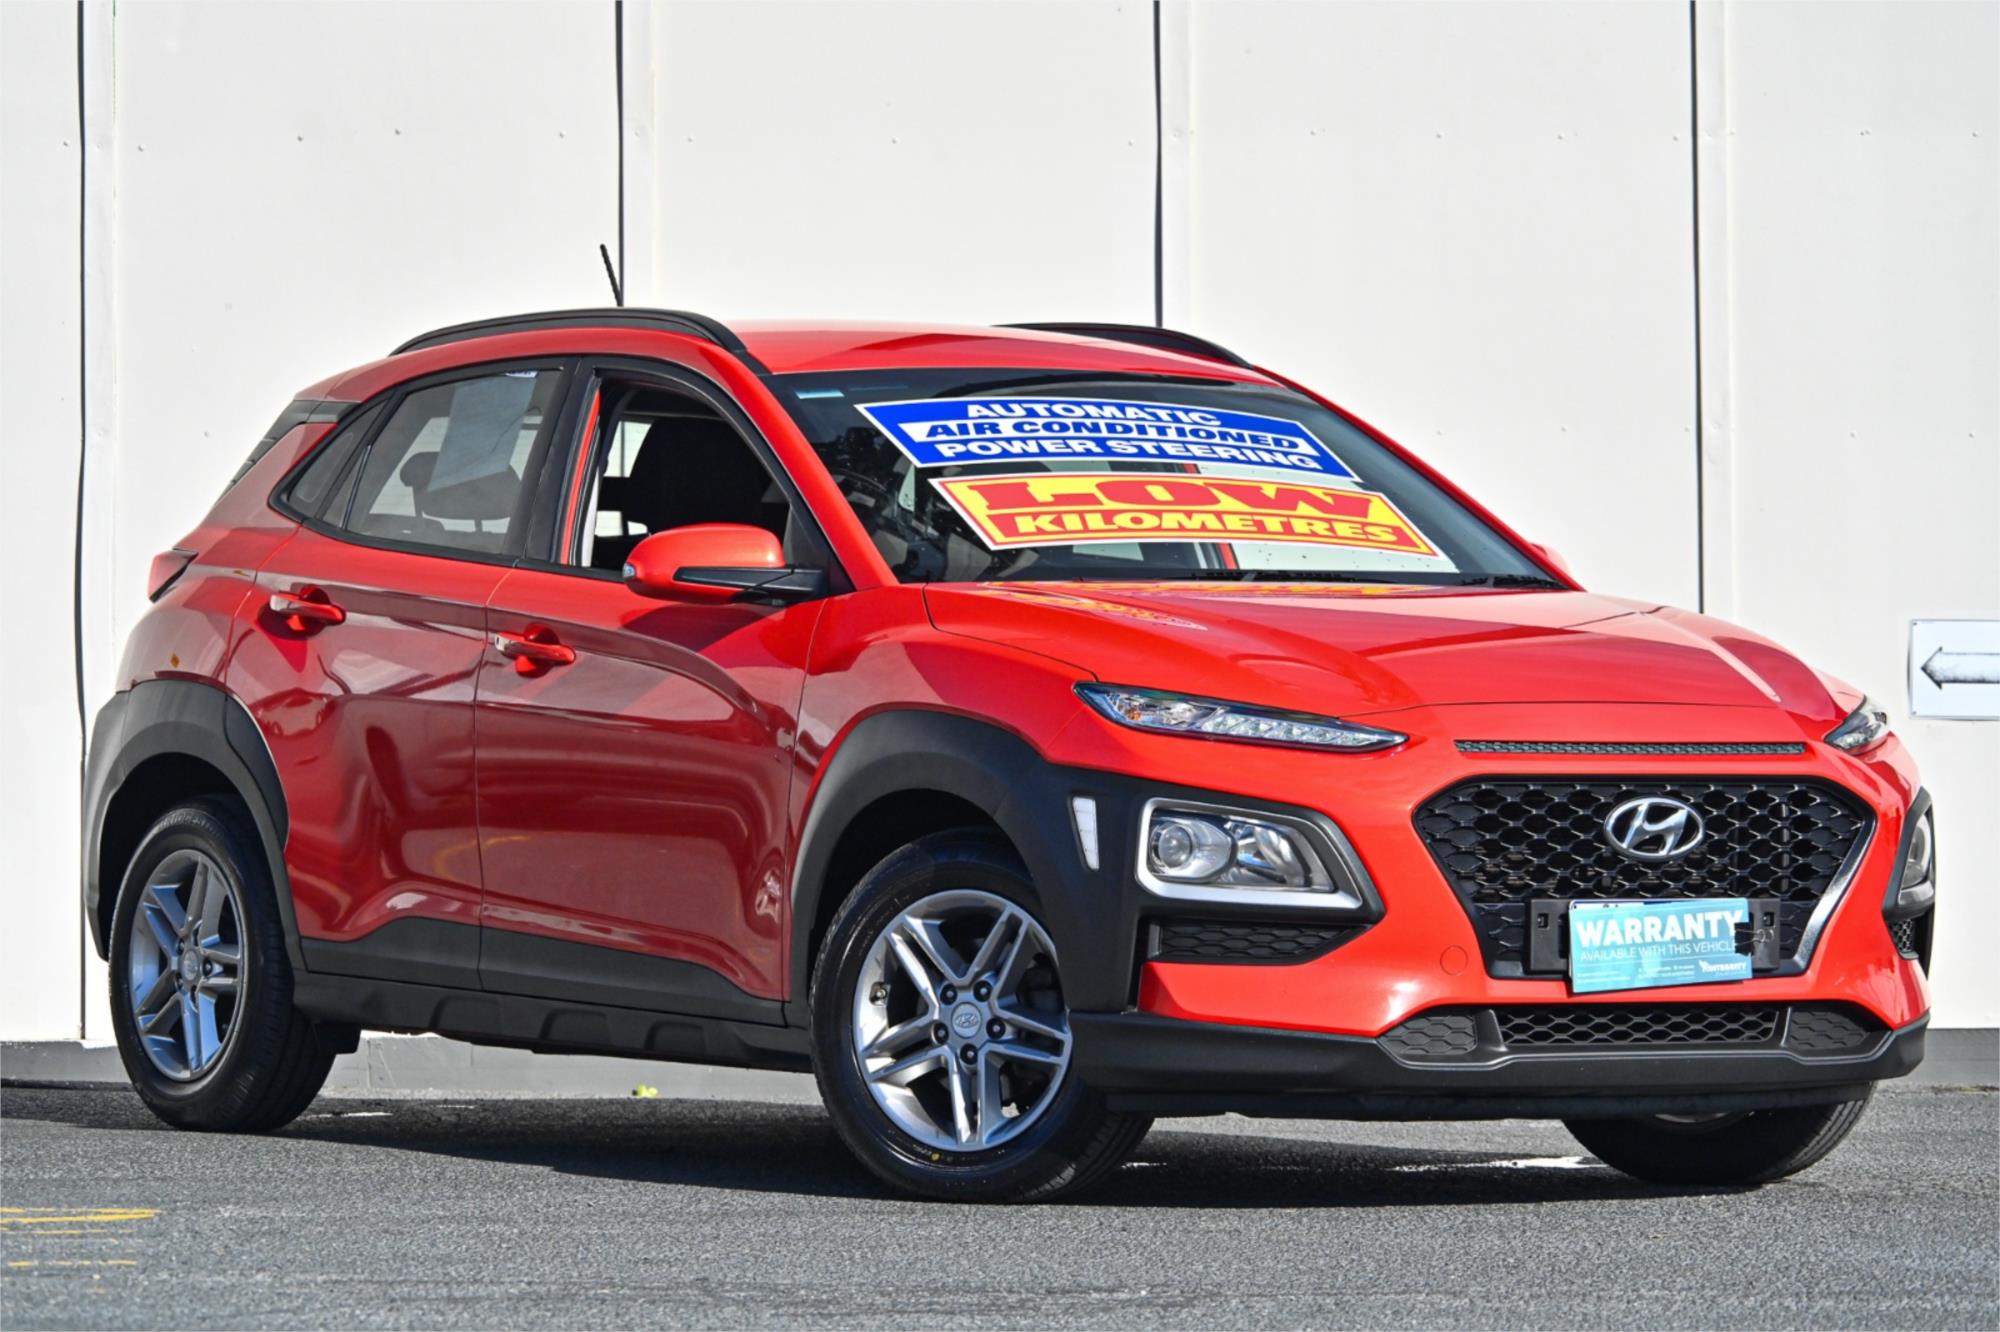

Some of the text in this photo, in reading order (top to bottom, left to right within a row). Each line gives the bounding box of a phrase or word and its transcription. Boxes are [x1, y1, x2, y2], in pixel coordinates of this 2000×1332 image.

[966, 403, 1222, 426] AUTOMATIC
[926, 421, 1299, 449] AIR CONDITIONED
[934, 439, 1323, 470] POWER STEERING
[967, 480, 1373, 519] LOW
[1014, 511, 1398, 542] KILOMETRES
[1575, 910, 1744, 948] WARRANTY
[1580, 946, 1637, 961] AVAILABLE
[1638, 944, 1666, 957] WITH
[1669, 942, 1691, 955] THIS
